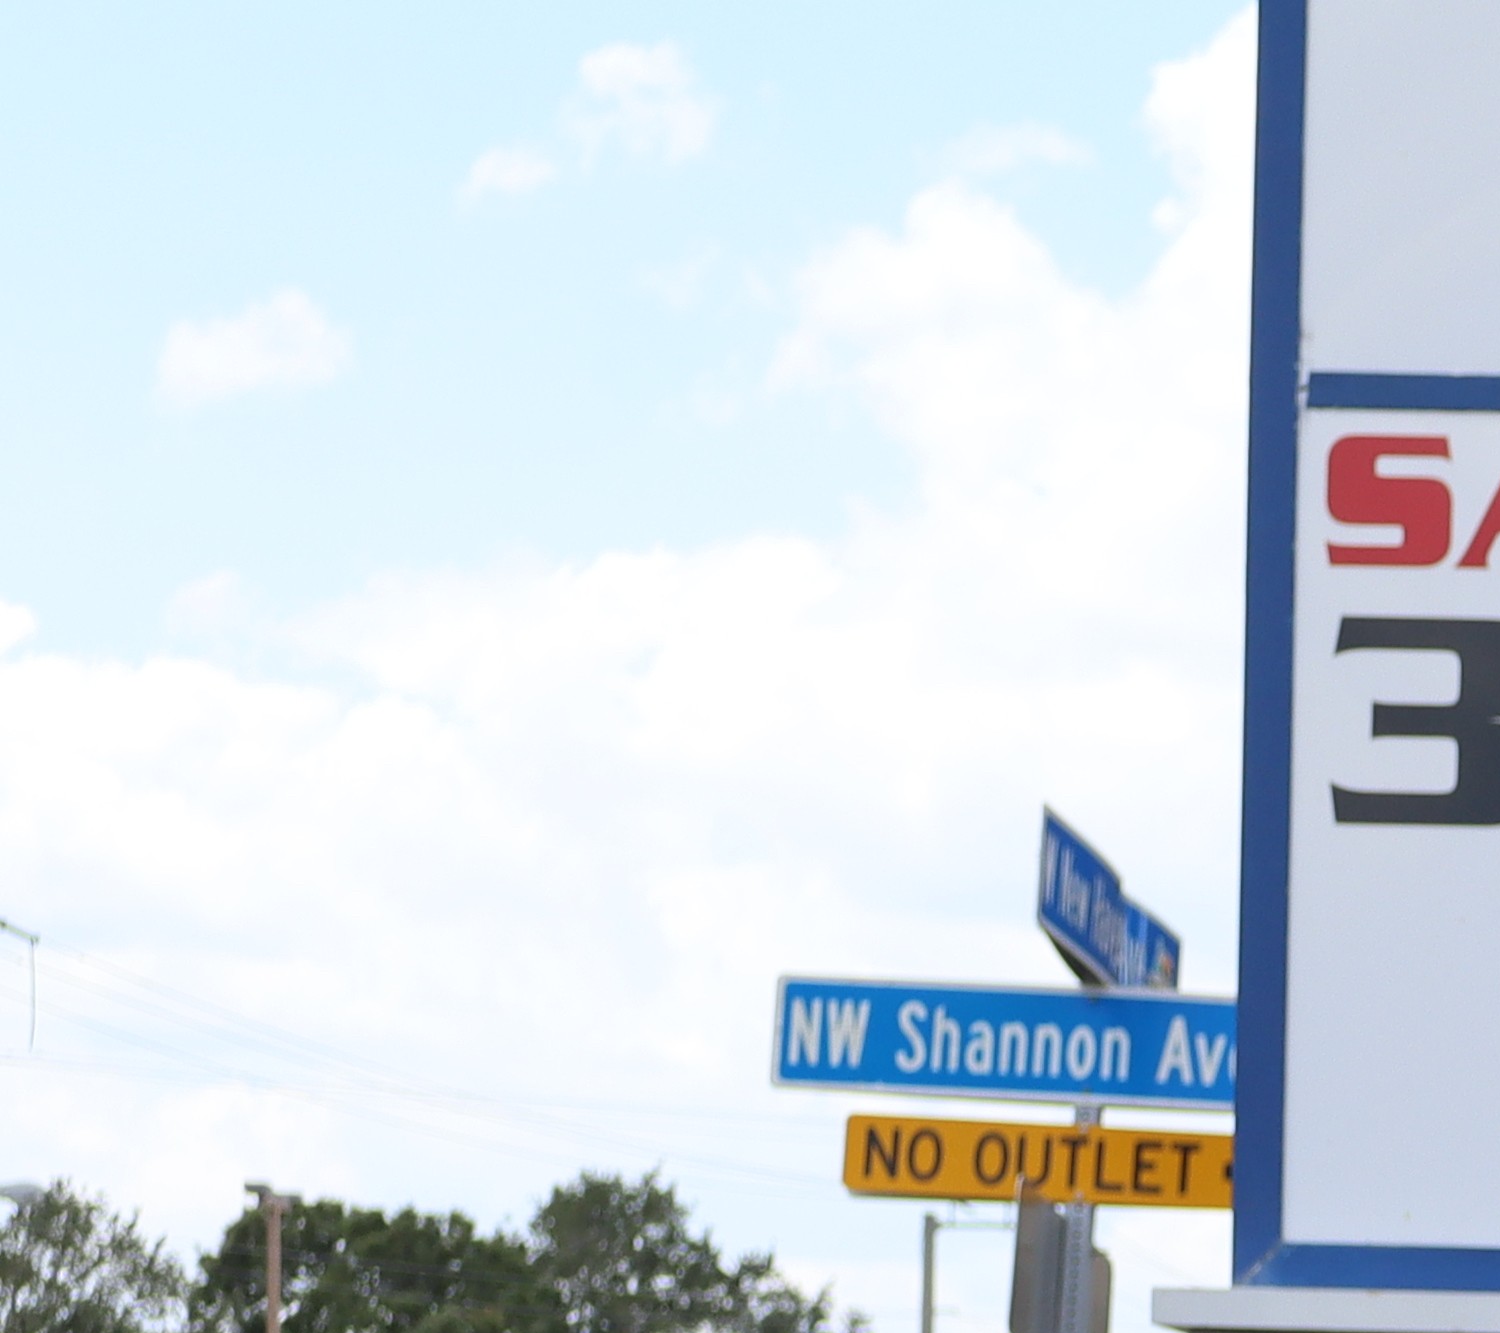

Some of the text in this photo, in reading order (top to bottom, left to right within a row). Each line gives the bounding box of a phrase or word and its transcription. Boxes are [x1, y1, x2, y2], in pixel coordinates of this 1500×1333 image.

[787, 996, 871, 1069] NW
[894, 1000, 1131, 1083] Shannon
[862, 1124, 1200, 1195] NO OUTLET
